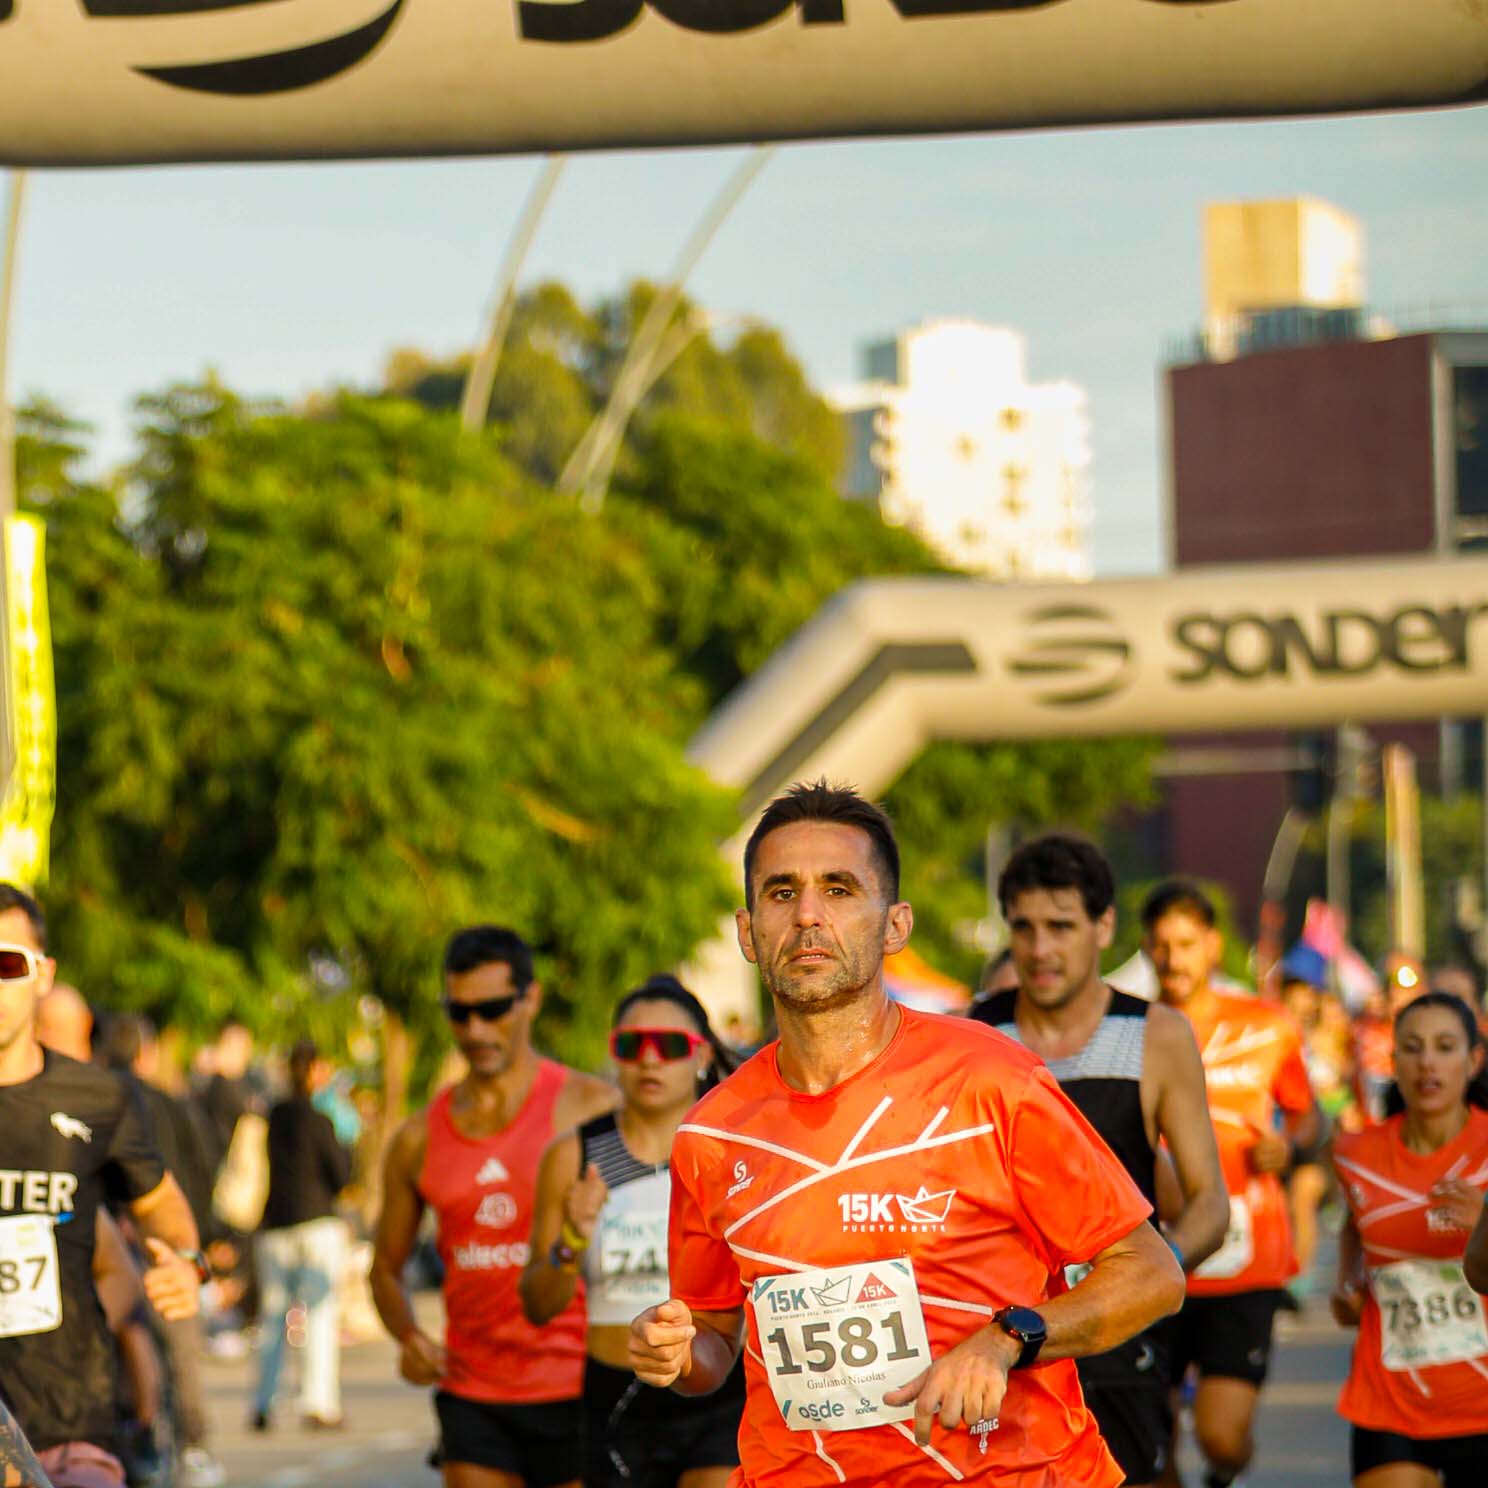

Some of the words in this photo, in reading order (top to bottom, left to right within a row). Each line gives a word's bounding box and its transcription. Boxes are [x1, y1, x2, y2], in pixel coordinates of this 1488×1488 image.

[837, 1193, 894, 1222] 15K
[842, 1224, 895, 1233] PUERTO
[767, 1287, 810, 1313] 15K
[862, 1283, 888, 1298] 15K
[767, 1311, 920, 1376] 1581
[798, 1399, 845, 1421] osde
